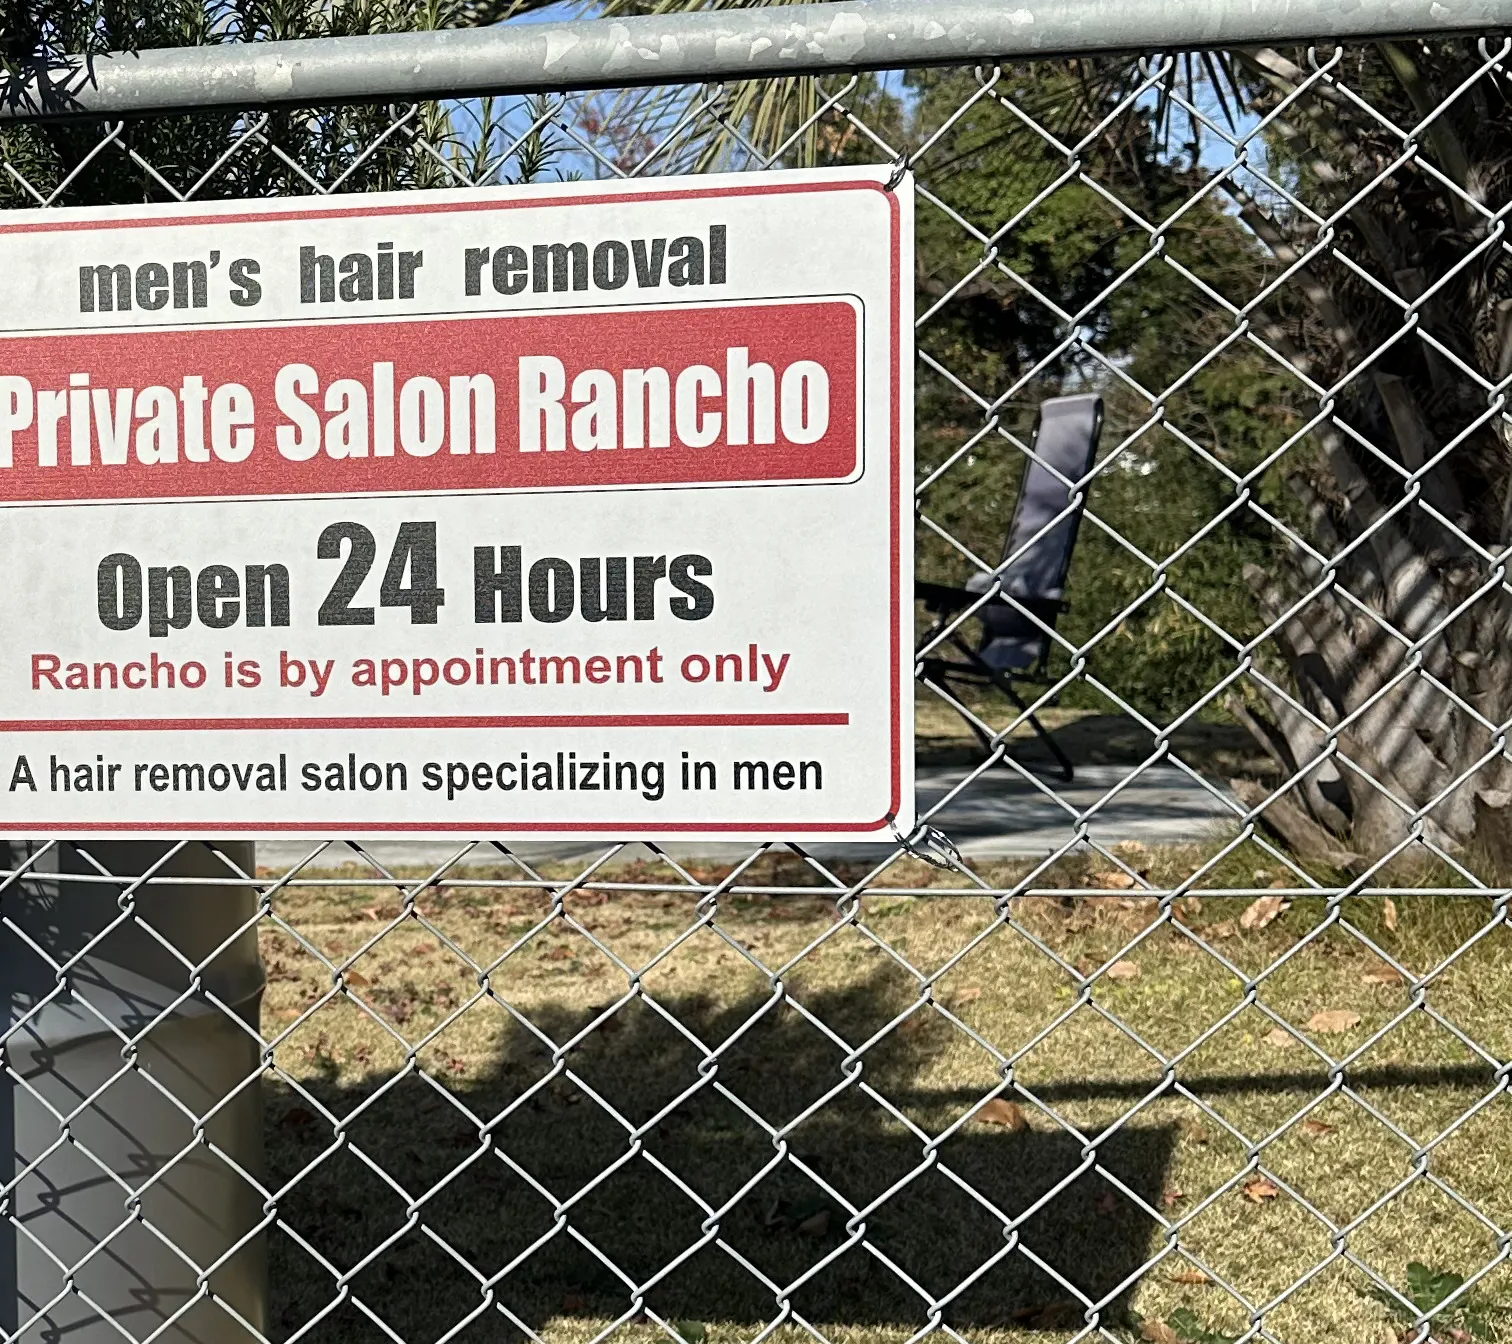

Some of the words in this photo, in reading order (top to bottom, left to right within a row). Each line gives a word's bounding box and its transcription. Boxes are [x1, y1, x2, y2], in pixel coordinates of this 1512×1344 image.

[80, 251, 261, 312] men's
[300, 242, 422, 303] hair
[464, 224, 727, 297] removal
[275, 362, 495, 461] Salon
[519, 347, 829, 452] Rancho
[98, 553, 290, 637] Open
[317, 522, 444, 626] 24
[474, 546, 714, 623] Hours
[32, 654, 206, 688] Rancho
[226, 651, 260, 687] is
[280, 652, 333, 696] by
[353, 649, 662, 695] appointment
[682, 645, 789, 691] only
[9, 756, 37, 791] A
[51, 755, 121, 792] hair
[135, 754, 286, 791] removal
[301, 753, 407, 791] salon
[422, 752, 664, 801] specializing
[682, 752, 716, 790] in
[734, 761, 822, 790] men
